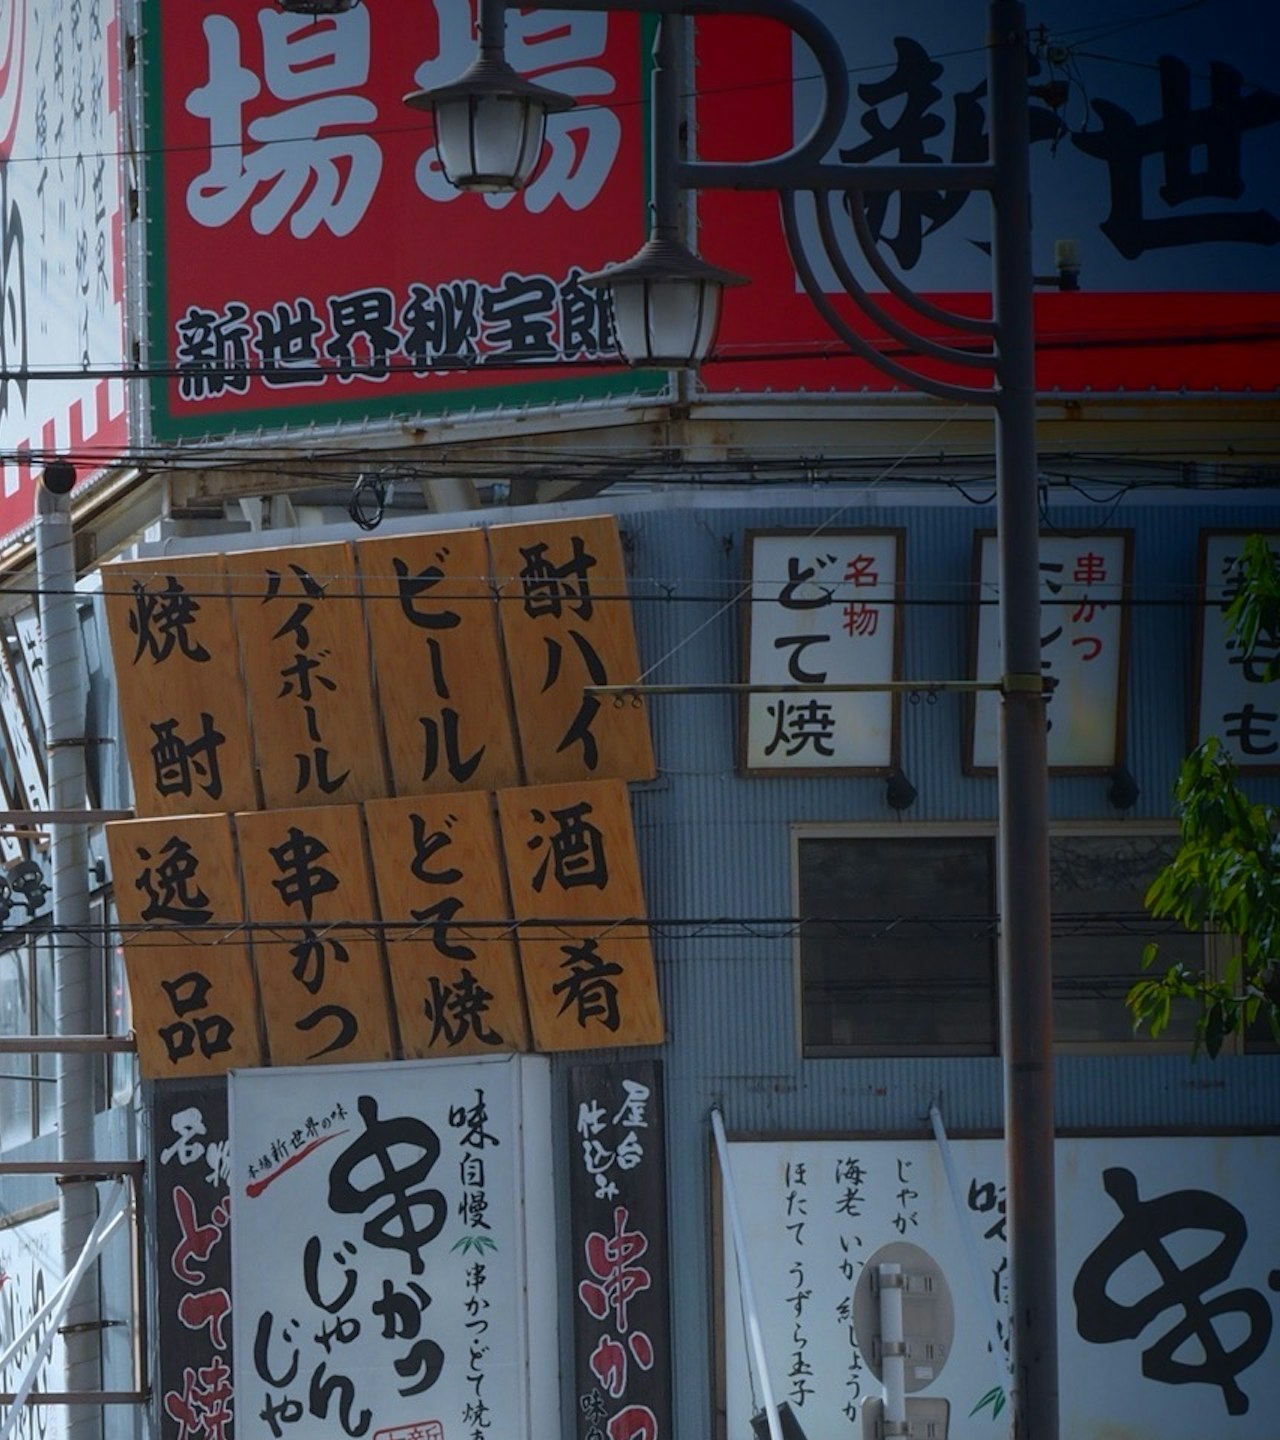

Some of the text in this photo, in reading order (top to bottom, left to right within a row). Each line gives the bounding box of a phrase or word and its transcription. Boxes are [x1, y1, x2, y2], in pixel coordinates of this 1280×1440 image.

[129, 576, 225, 800] 焼酎
[262, 563, 352, 796] ハイボール
[392, 547, 486, 784] ビール
[520, 536, 609, 771] 酎ハイ
[763, 552, 837, 757] どて焼
[843, 554, 880, 638] 名物
[1071, 551, 1108, 662] 串かつ
[135, 835, 235, 1065] 逸品
[268, 827, 358, 1061] 串かつ
[408, 813, 502, 1048] どて焼
[526, 802, 624, 1033] 酒肴
[246, 1102, 348, 1179] 本場新世界の味
[327, 1094, 447, 1397] 串かつ
[448, 1088, 500, 1231] 味自慢
[835, 1157, 868, 1217] 海老
[785, 1162, 816, 1408] ほたて うずら玉子
